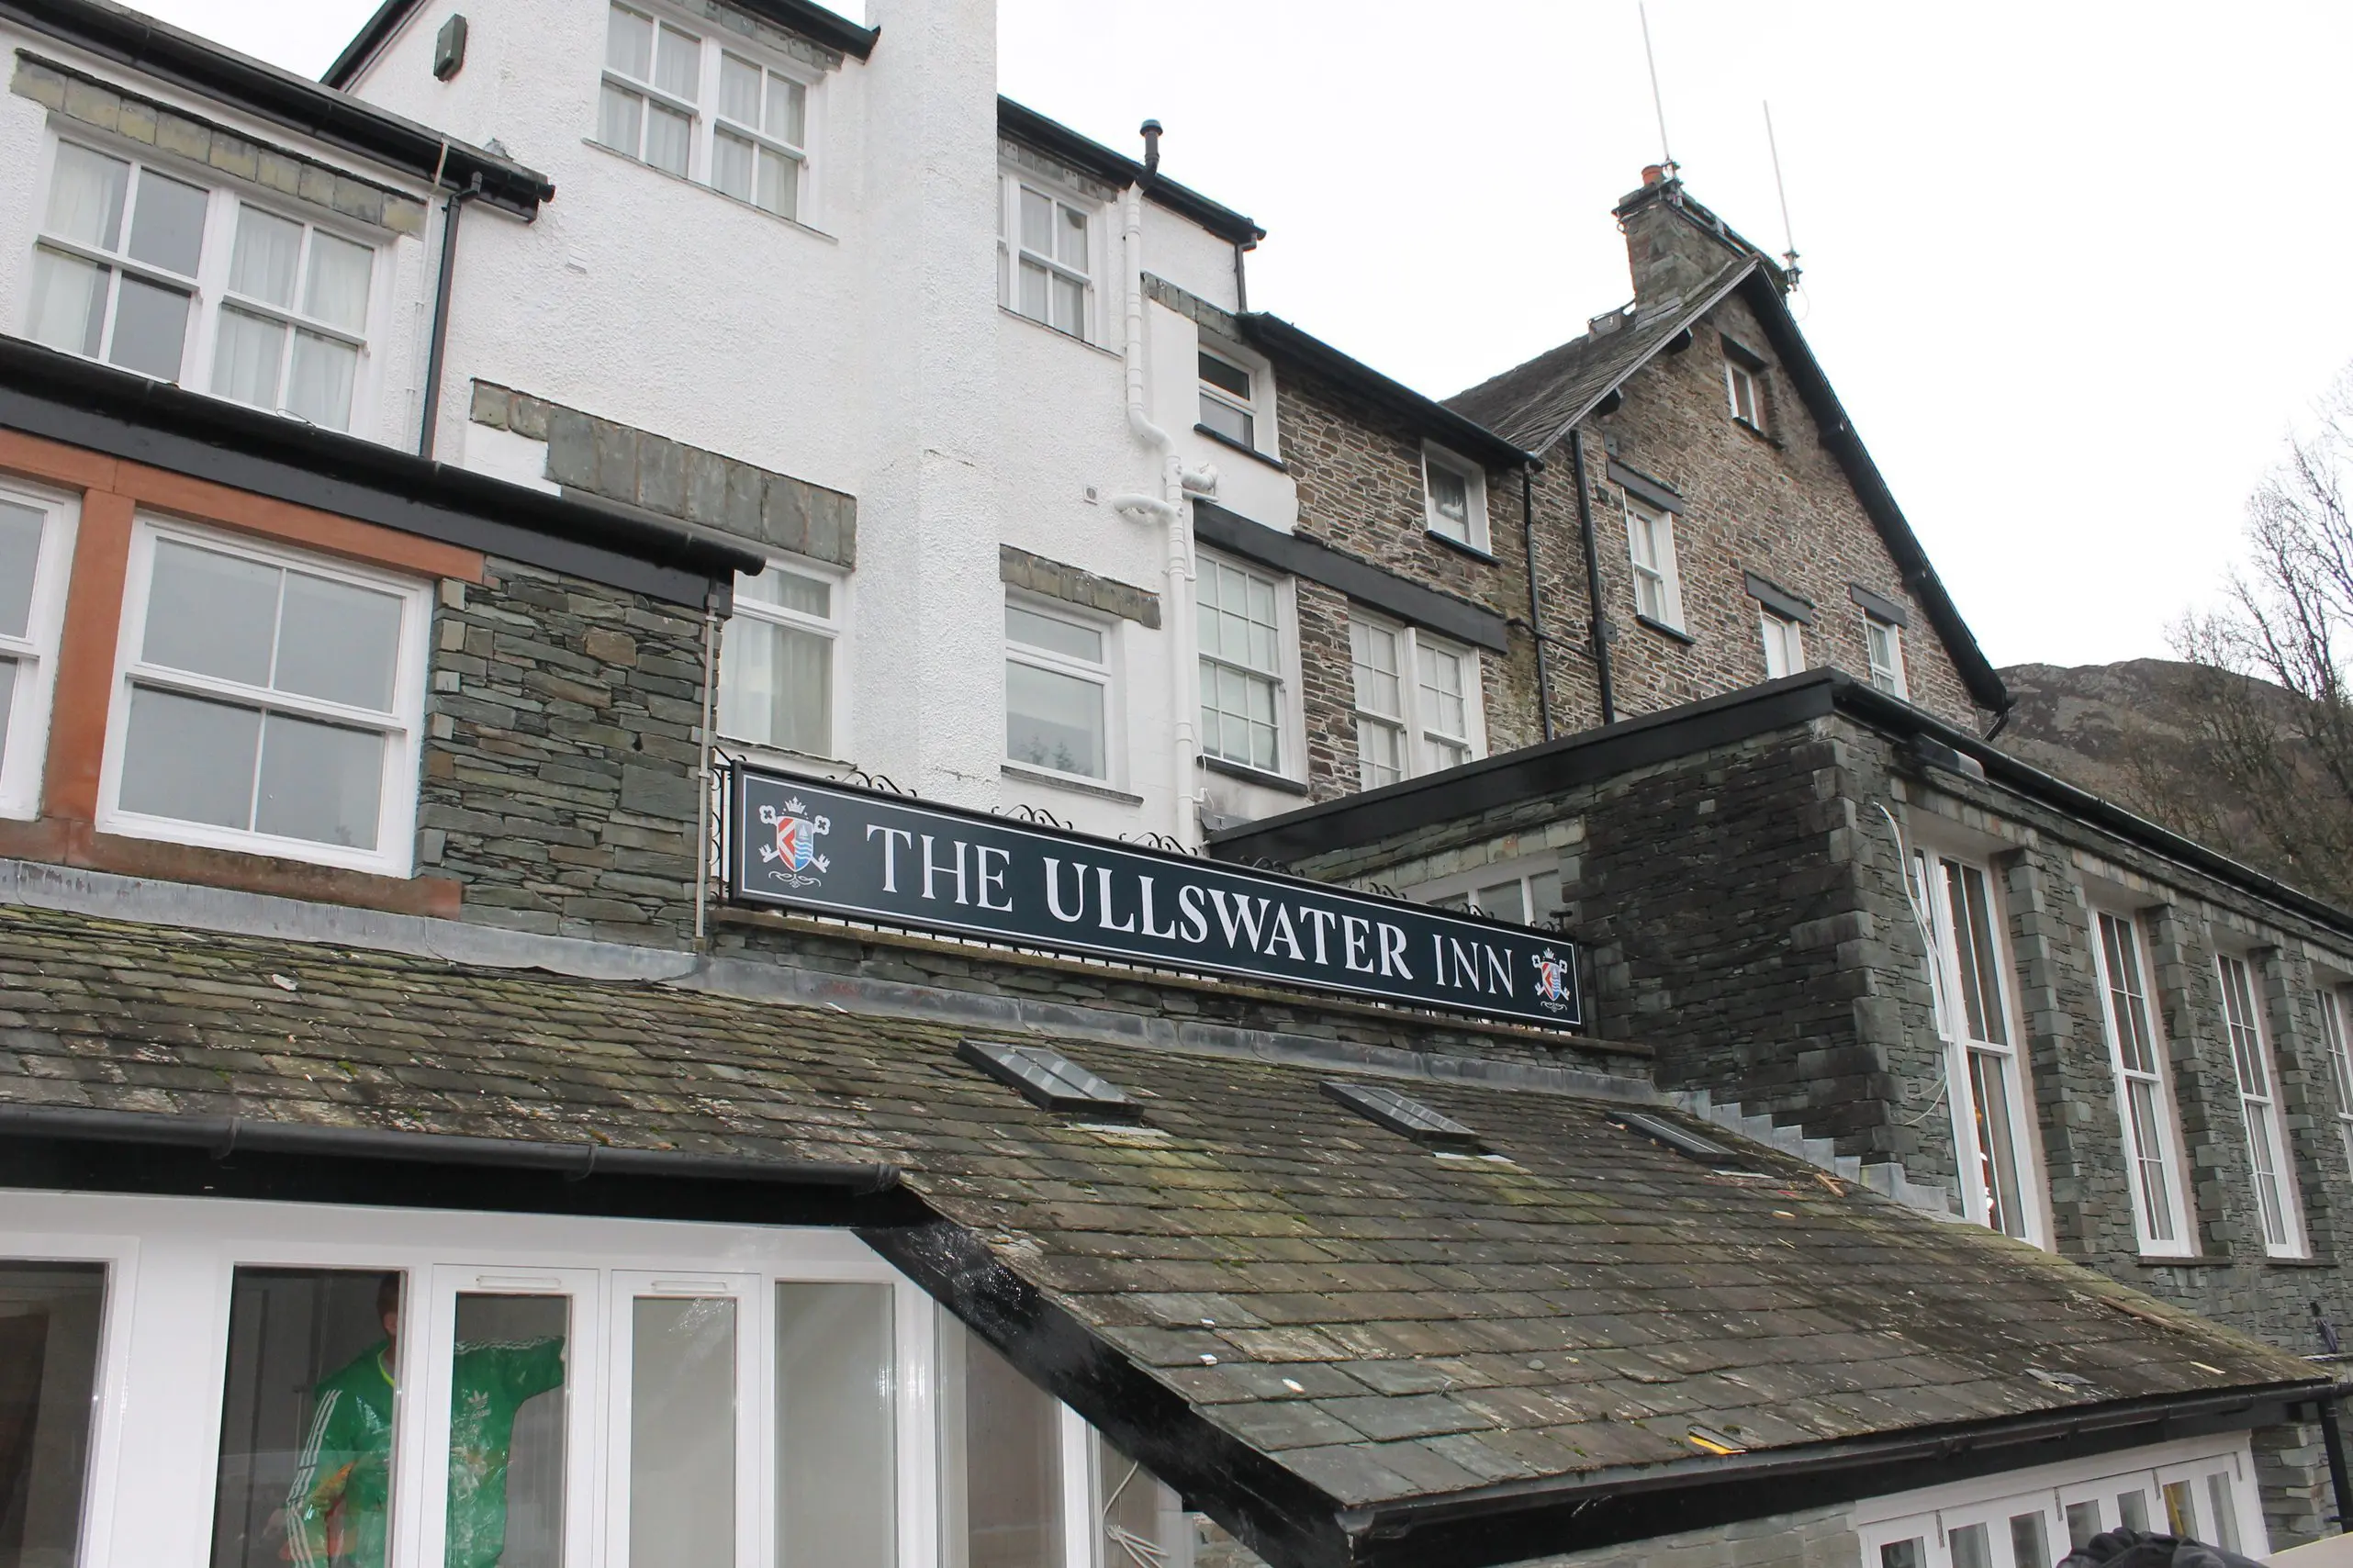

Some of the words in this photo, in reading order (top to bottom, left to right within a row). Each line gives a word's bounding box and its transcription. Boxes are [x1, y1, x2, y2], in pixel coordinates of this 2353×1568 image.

[867, 823, 1013, 913] THE
[1042, 857, 1414, 980] ULLSWATER
[1432, 934, 1514, 998] INN
